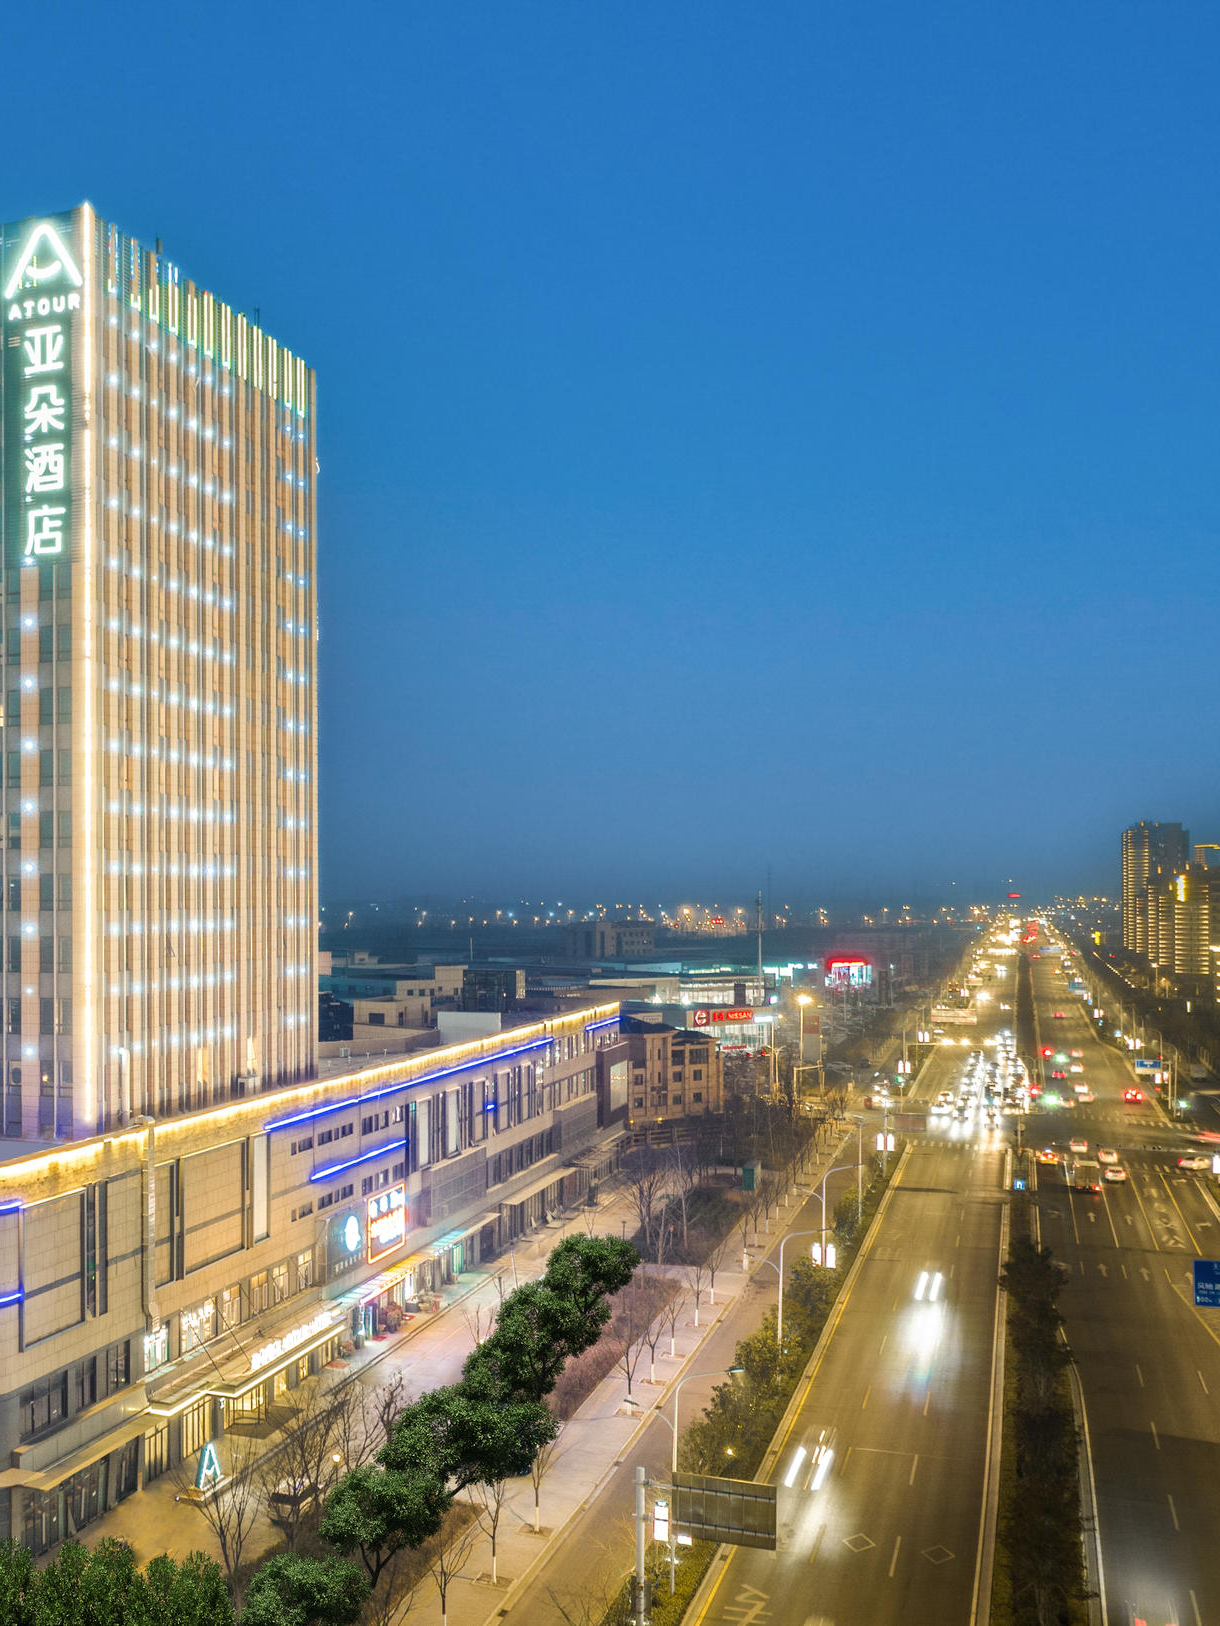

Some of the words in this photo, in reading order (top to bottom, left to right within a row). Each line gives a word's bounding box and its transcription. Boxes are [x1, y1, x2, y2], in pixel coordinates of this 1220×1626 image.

[8, 293, 81, 321] ATOUR
[24, 324, 66, 556] 亚朵酒店
[727, 1010, 753, 1020] NISSAN
